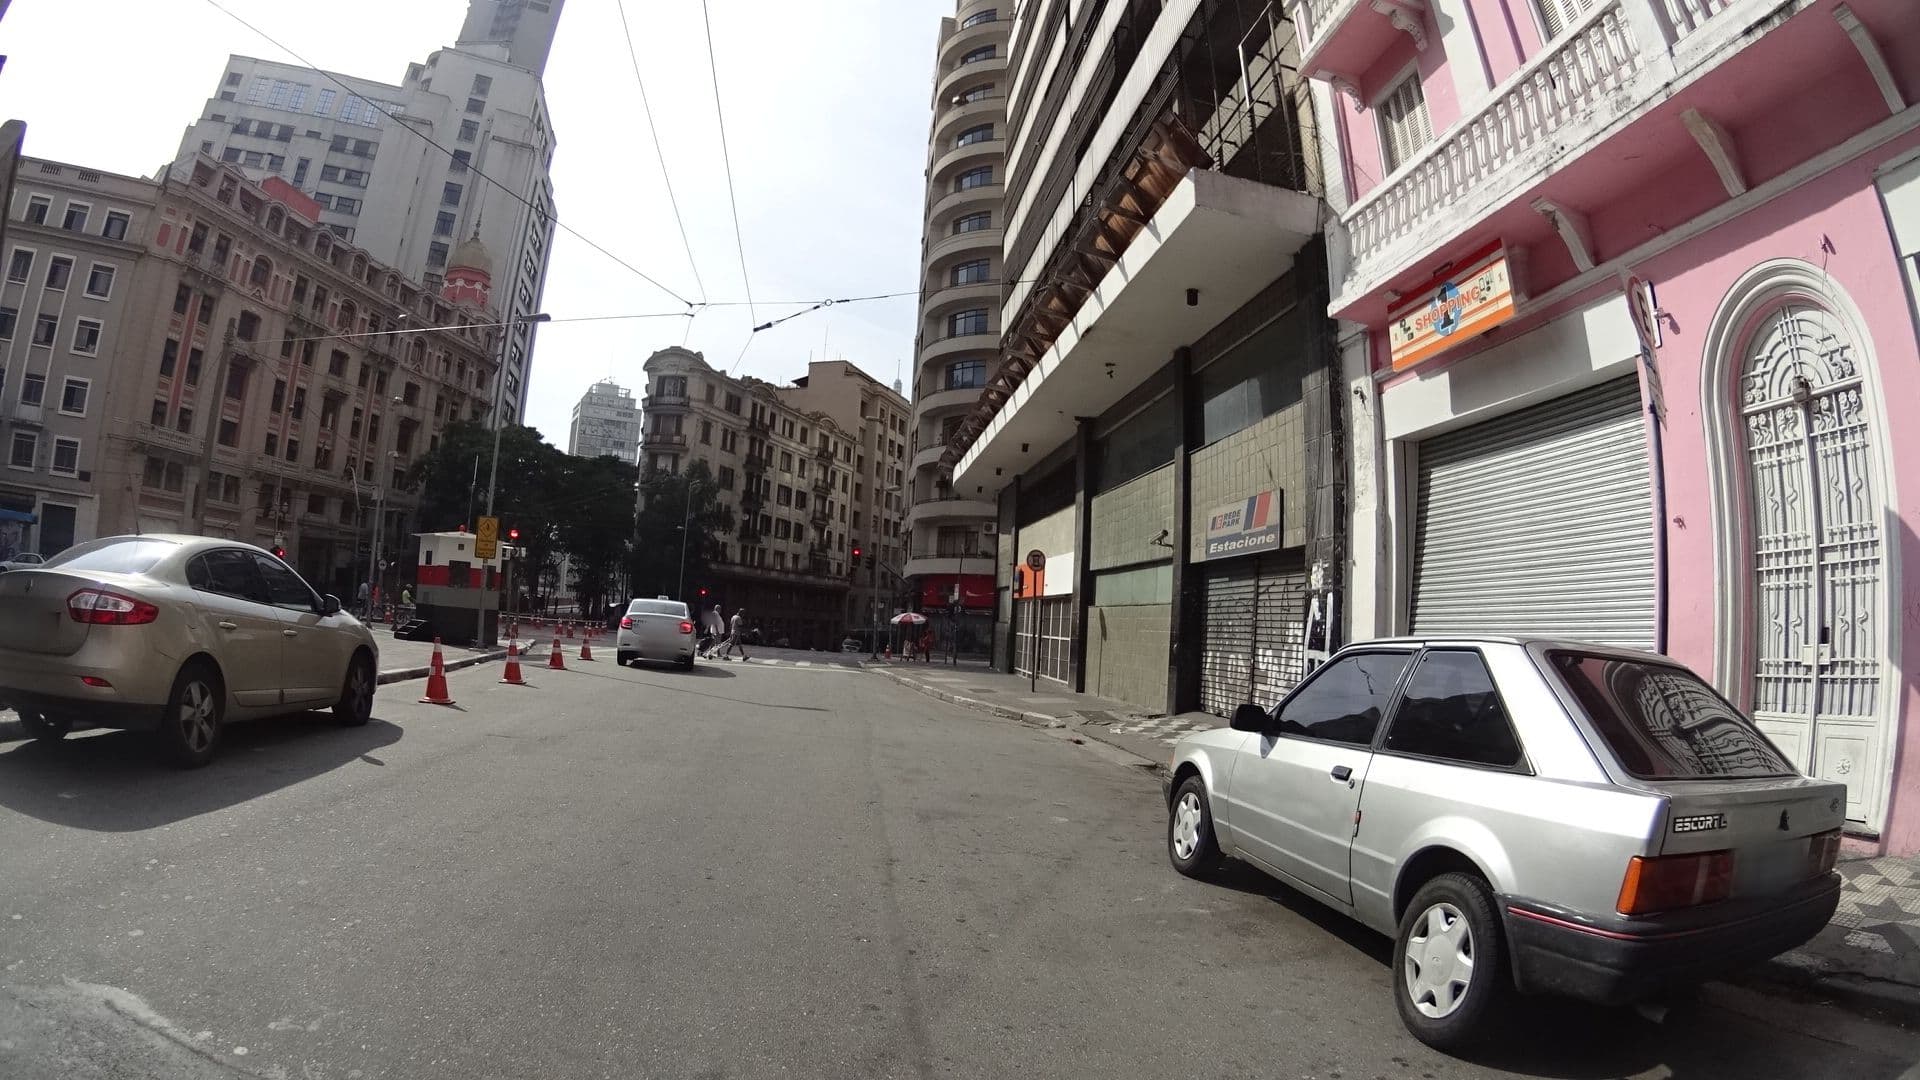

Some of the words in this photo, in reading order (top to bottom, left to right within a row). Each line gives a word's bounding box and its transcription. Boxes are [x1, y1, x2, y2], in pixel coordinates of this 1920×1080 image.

[1415, 286, 1480, 331] SHOPPING
[1223, 509, 1241, 521] REDE
[1222, 518, 1240, 530] PARK
[1210, 533, 1275, 553] Estacione
[1674, 815, 1719, 832] ESCORT
